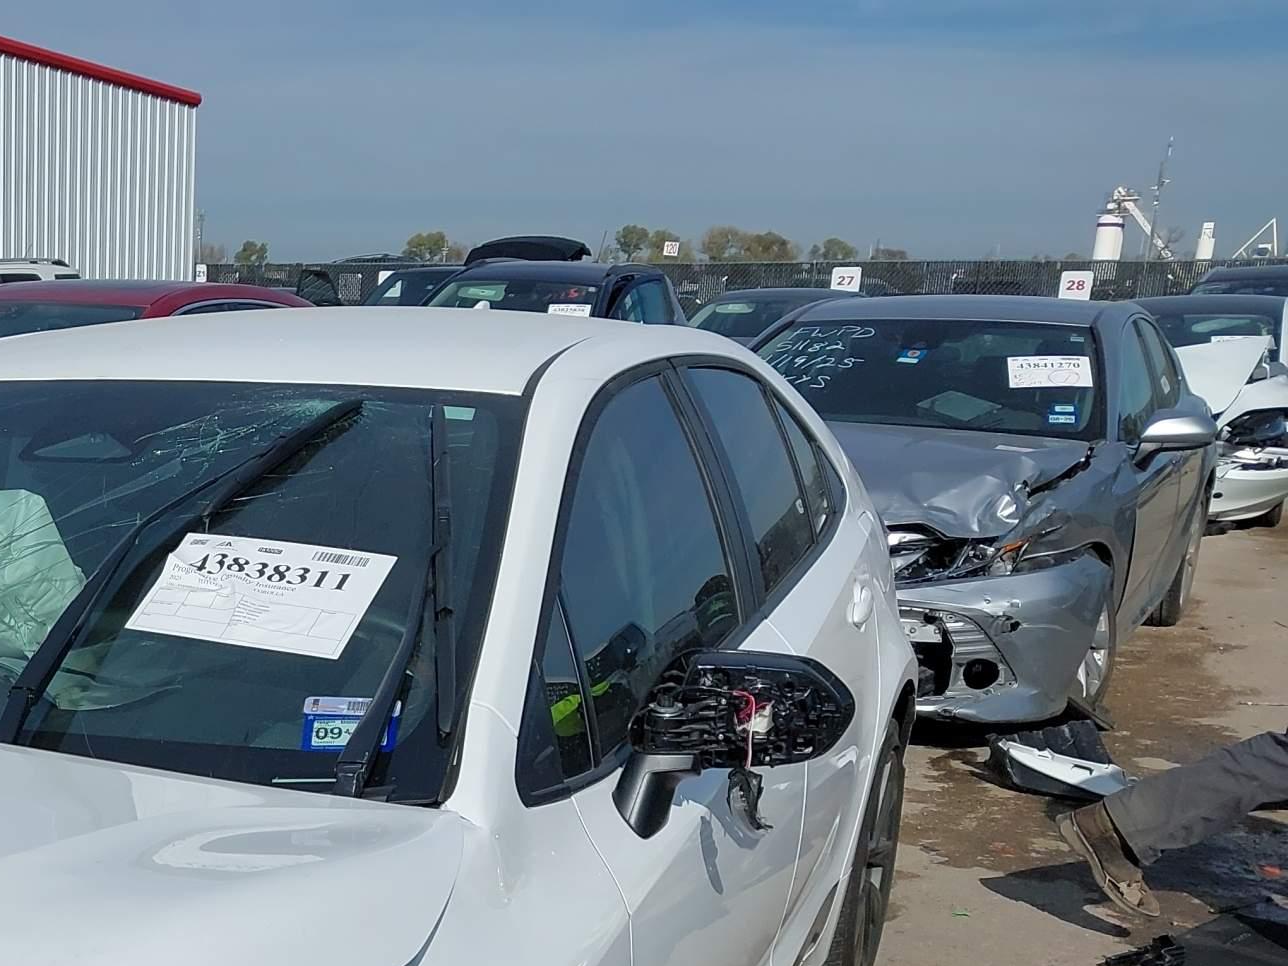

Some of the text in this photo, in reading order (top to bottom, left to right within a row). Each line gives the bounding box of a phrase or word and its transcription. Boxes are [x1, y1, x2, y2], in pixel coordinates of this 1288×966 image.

[836, 275, 855, 287] 27
[1066, 279, 1087, 292] 28
[189, 553, 352, 591] 43838311
[255, 581, 297, 592] Insurance
[315, 726, 343, 740] 09
